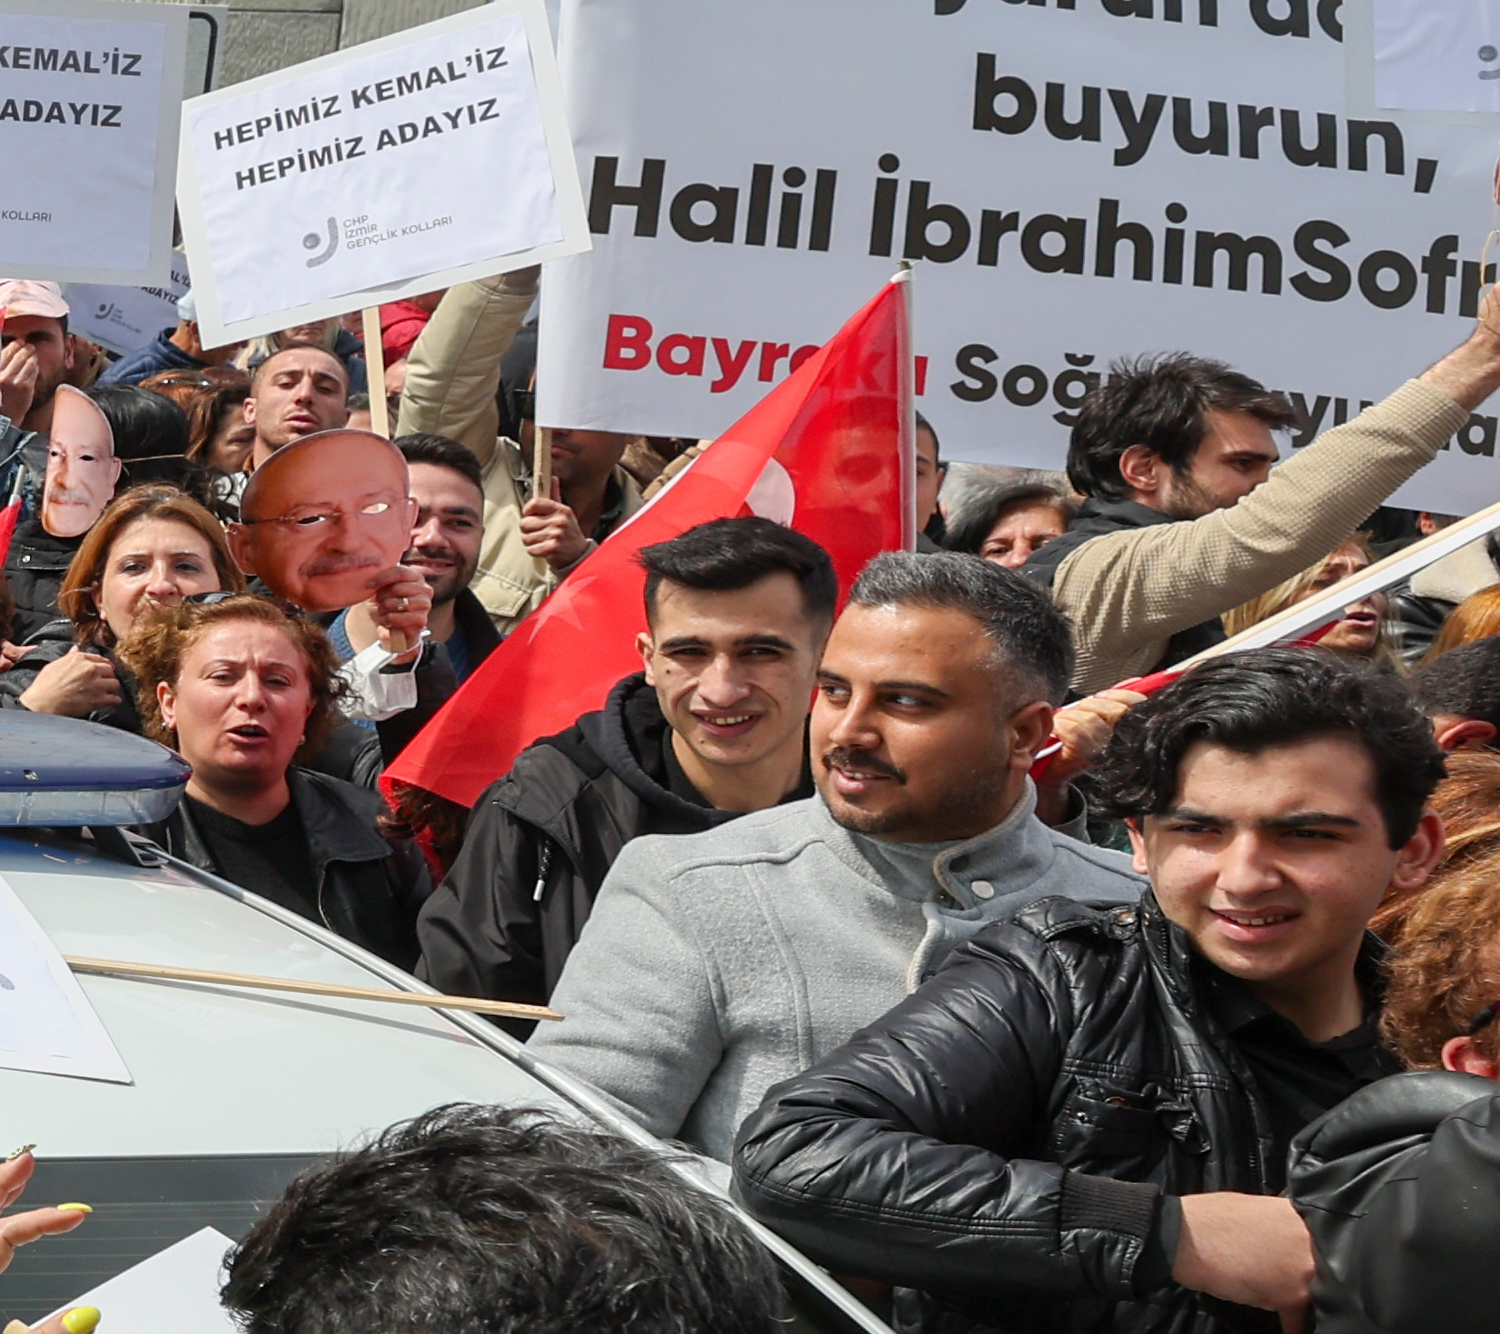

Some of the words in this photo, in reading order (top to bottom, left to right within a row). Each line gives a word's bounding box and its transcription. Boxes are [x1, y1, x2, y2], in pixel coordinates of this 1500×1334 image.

[214, 95, 342, 150] HEPİMİZ
[351, 47, 508, 109] KEMAL'İZ
[235, 136, 366, 190] HEPİMİZ
[376, 98, 500, 151] ADAYIZ
[971, 51, 1441, 195] buyurun,
[1, 210, 52, 222] KOLLARI
[343, 215, 369, 228] CHP
[346, 229, 398, 249] GENÇLİK
[402, 216, 452, 236] KOLLARI
[587, 154, 837, 254] Halil
